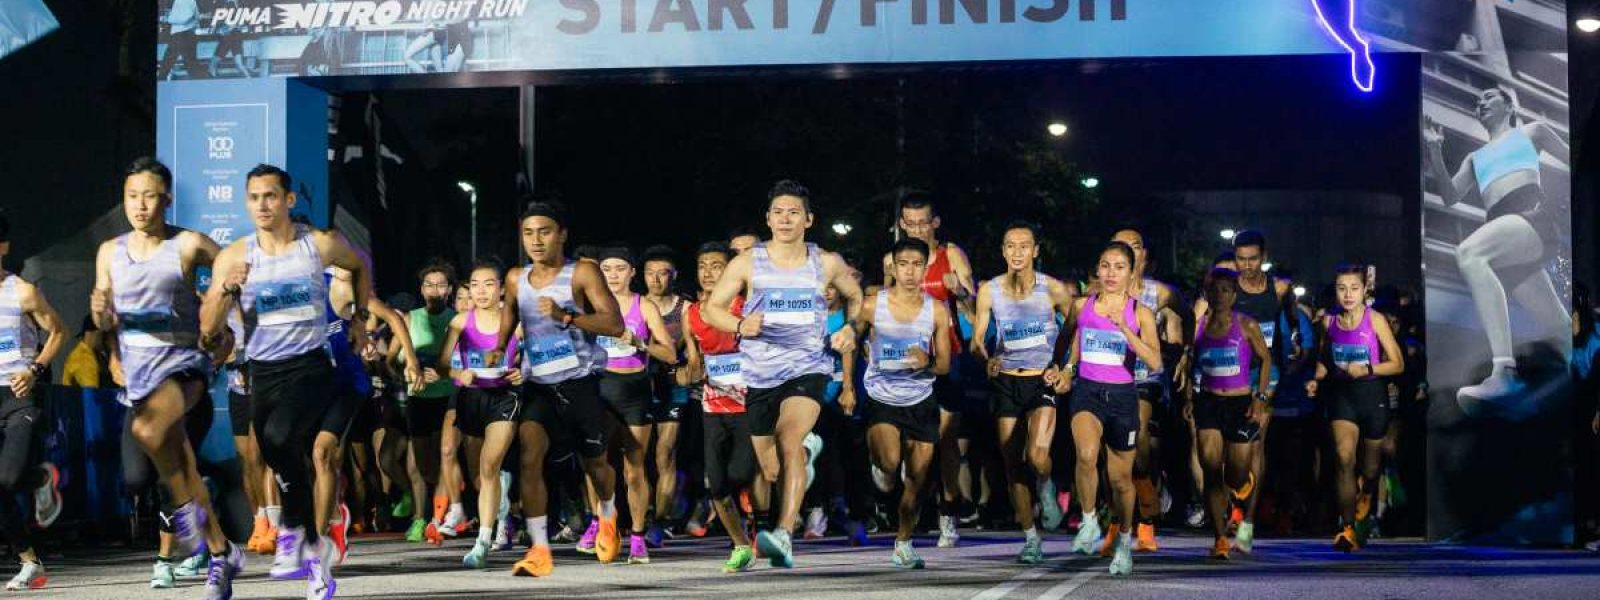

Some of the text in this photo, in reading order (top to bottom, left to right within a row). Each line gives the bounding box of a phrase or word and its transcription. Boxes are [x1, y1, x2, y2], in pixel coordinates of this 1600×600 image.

[211, 0, 527, 29] PUMA NITRO NIGHT RUN
[207, 136, 234, 151] 100
[208, 185, 232, 200] NB
[769, 299, 785, 309] MP
